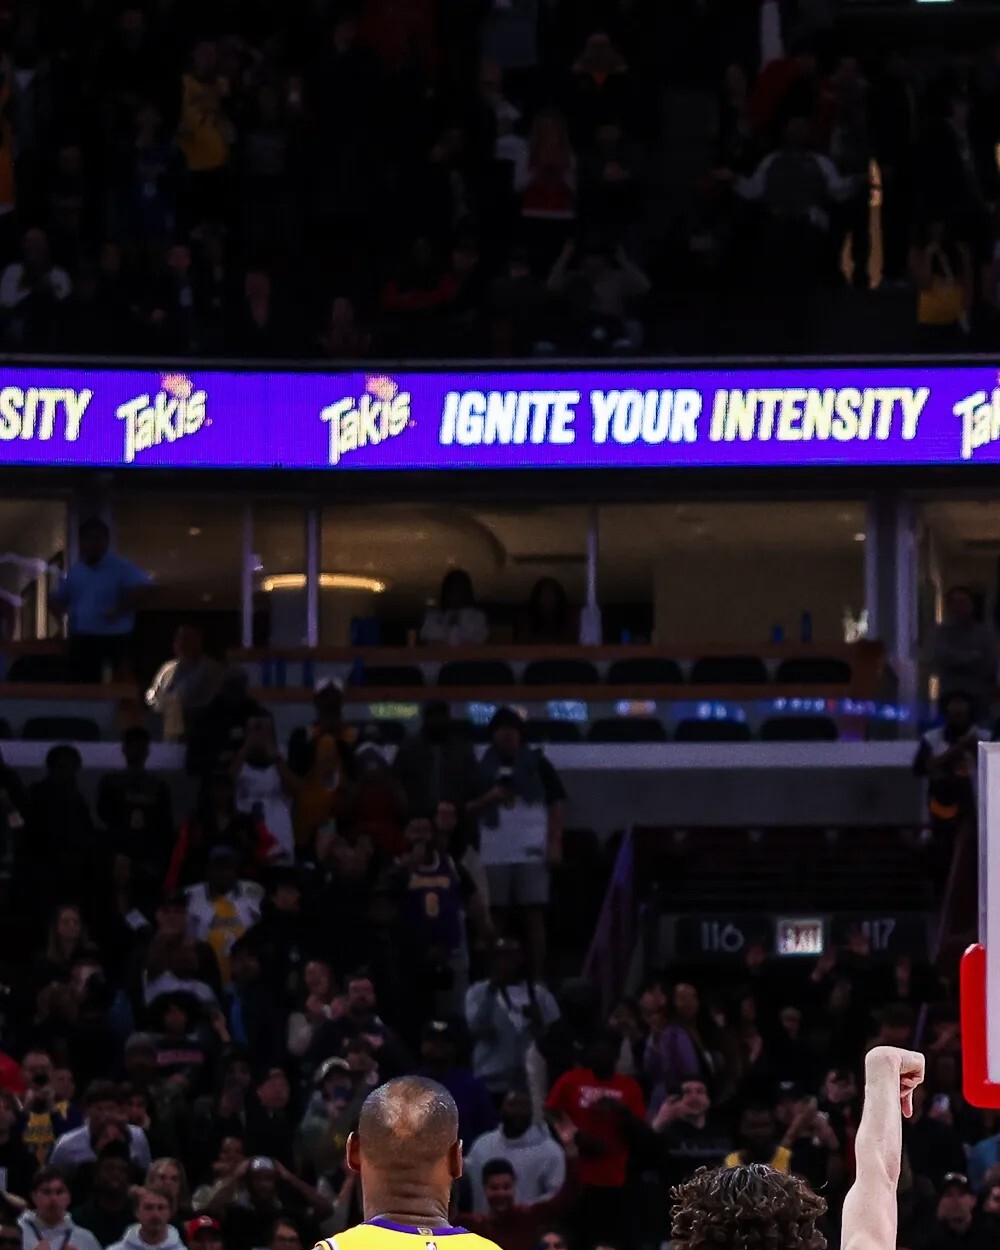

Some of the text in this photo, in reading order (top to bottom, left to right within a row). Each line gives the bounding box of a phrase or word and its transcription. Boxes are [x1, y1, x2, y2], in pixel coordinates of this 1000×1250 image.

[115, 390, 207, 463] Takis
[320, 391, 412, 465] Takis
[439, 387, 930, 444] IGNITE YOUR INTENSITY
[701, 920, 745, 951] 116
